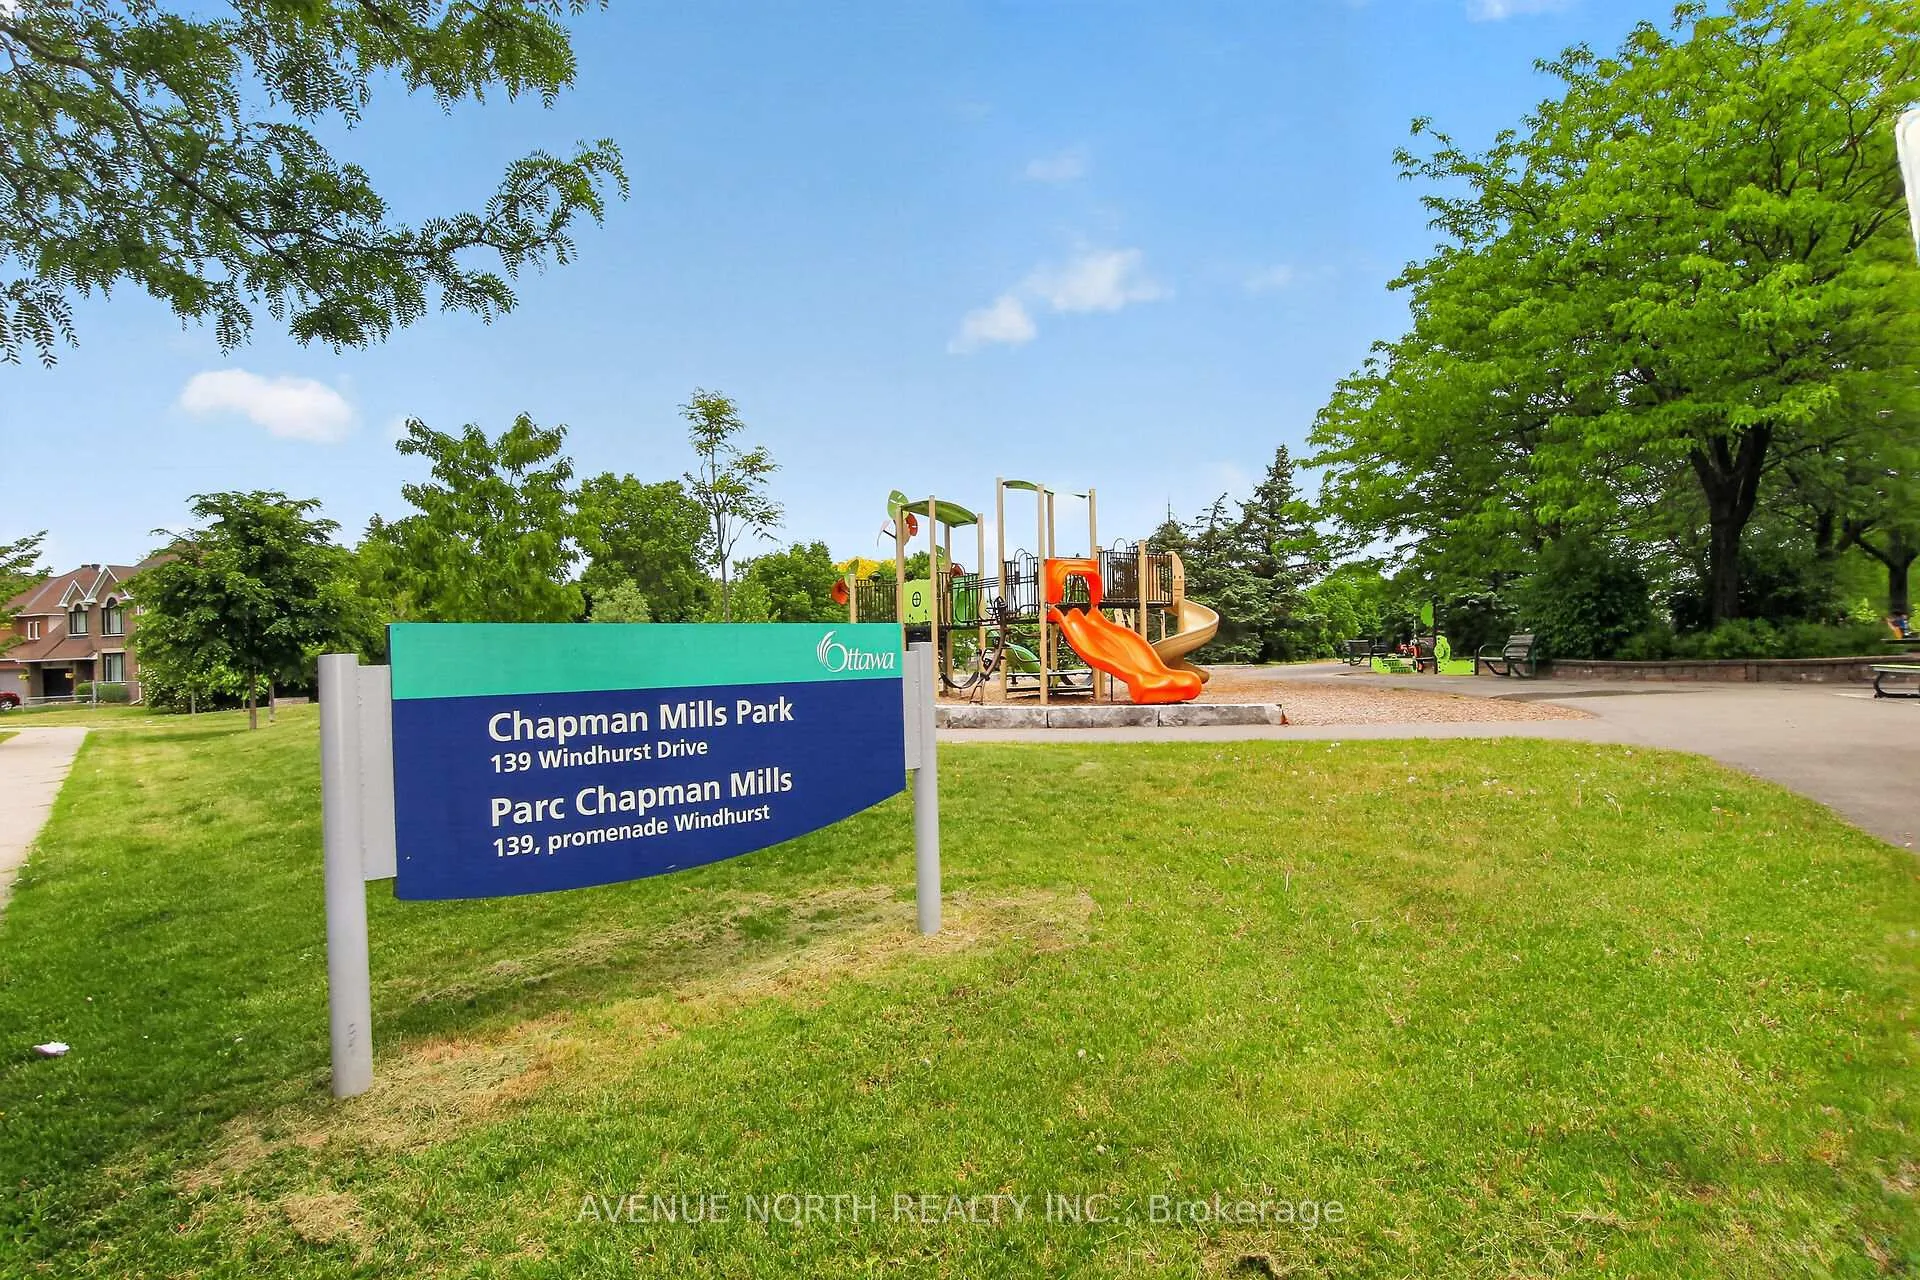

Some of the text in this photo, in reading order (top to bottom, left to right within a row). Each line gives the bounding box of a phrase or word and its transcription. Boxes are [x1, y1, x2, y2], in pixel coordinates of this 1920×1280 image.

[817, 631, 895, 673] Ottawa
[488, 696, 795, 746] Chapman Mills Park
[491, 738, 709, 773] 139 Windhurst Drive
[489, 766, 794, 827] Parc Chapman Mills
[493, 803, 771, 858] 139, promenade Windhurst
